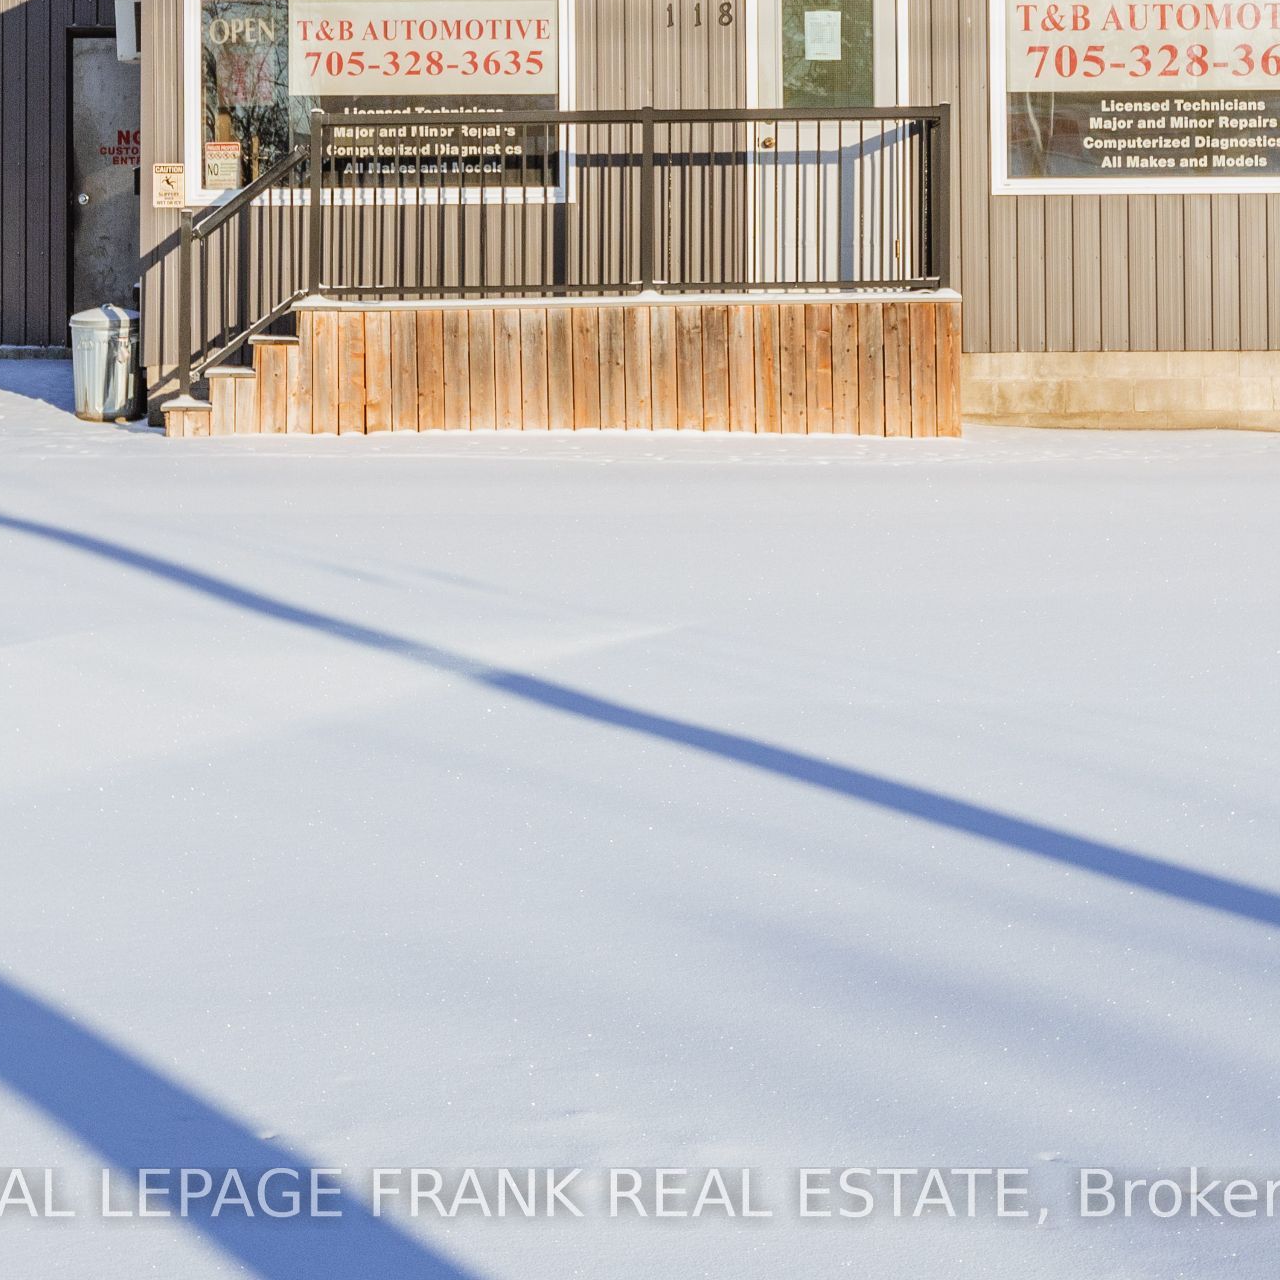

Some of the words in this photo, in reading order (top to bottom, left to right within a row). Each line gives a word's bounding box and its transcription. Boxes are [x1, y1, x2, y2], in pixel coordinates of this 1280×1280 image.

[666, 1, 733, 28] 118
[1016, 3, 1092, 32] T&B
[209, 17, 275, 45] OPEN
[296, 19, 354, 41] T&B
[361, 18, 551, 41] AUTOMOTIVE
[304, 49, 544, 77] 705-328-3635
[1101, 99, 1170, 113] Licensed
[1174, 99, 1266, 113] Technicians
[379, 125, 407, 138] and
[1089, 116, 1133, 132] Major
[1137, 116, 1166, 130] and
[1170, 116, 1215, 130] Minor
[1219, 115, 1278, 131] Repairs
[1083, 136, 1191, 152] Computerized
[207, 163, 219, 176] NO
[420, 162, 448, 174] and
[1101, 155, 1122, 169] All
[1126, 155, 1176, 169] Makes
[1180, 155, 1208, 169] and
[1212, 154, 1268, 169] Models
